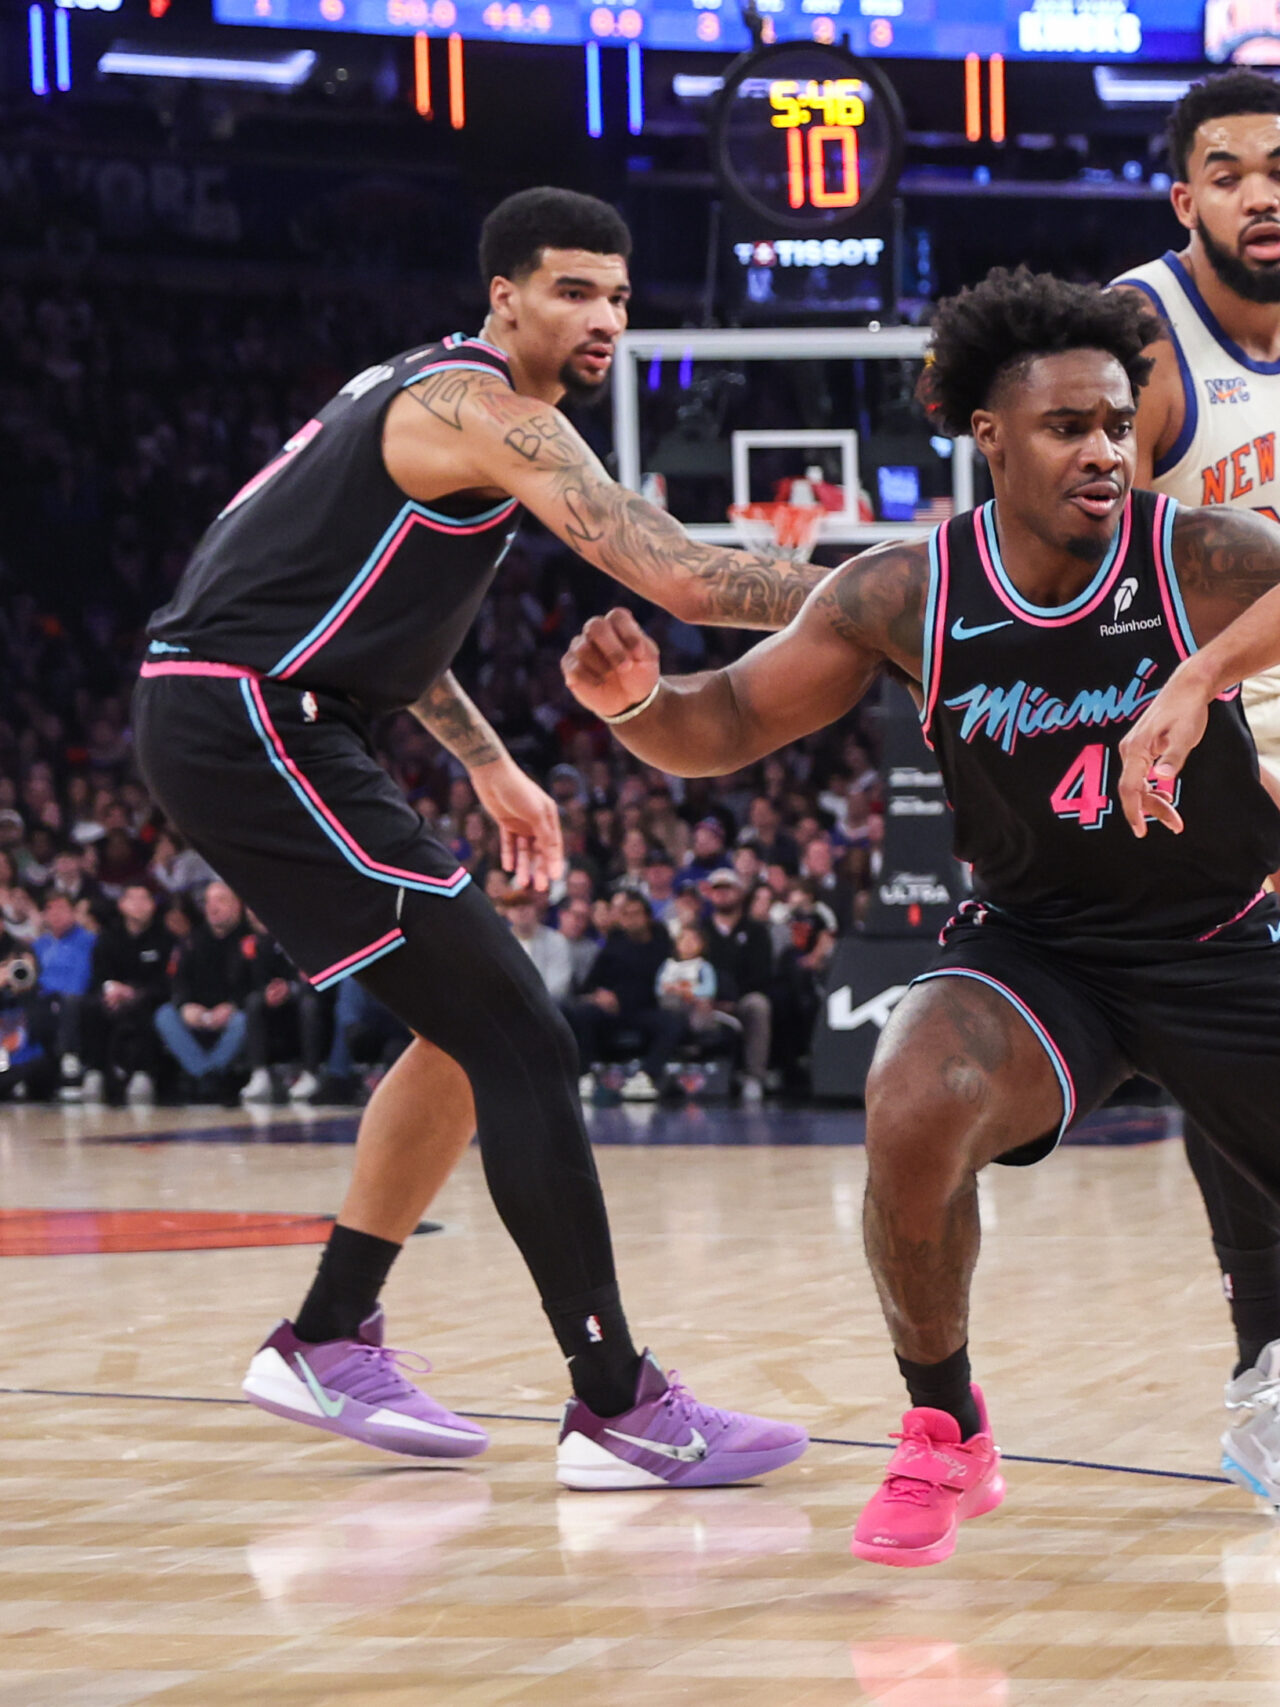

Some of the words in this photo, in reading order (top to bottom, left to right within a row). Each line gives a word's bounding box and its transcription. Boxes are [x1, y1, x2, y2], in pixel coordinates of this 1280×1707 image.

[770, 78, 865, 127] 5:46
[787, 125, 859, 208] 10
[774, 238, 885, 267] TISSOT
[1201, 432, 1276, 506] NEW
[1099, 614, 1162, 638] Robinhood
[944, 657, 1162, 755] Miami
[1050, 743, 1181, 841] 4
[879, 884, 951, 906] ULTRA
